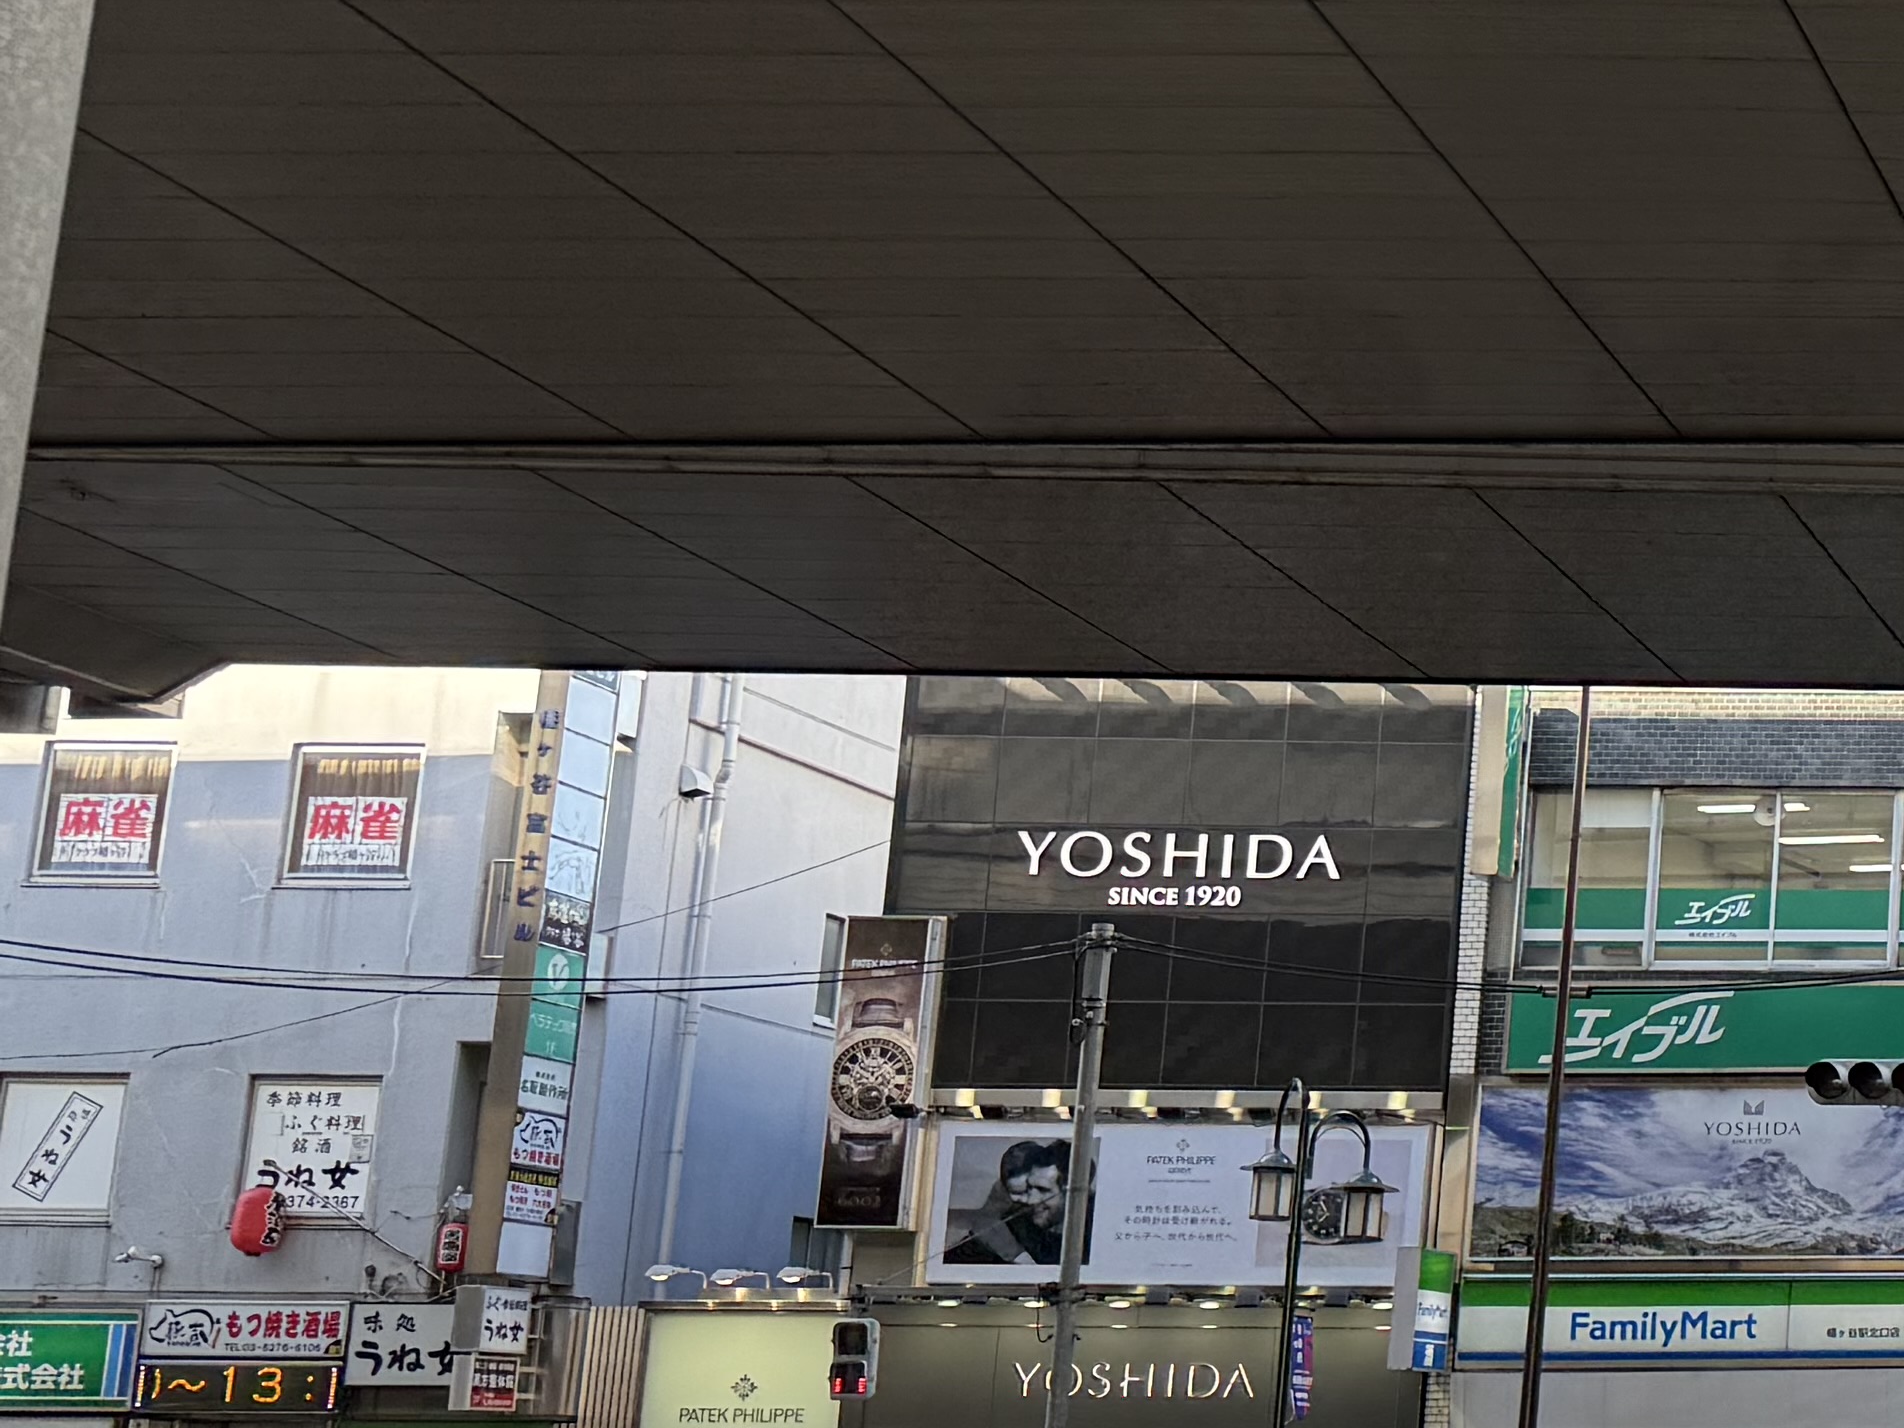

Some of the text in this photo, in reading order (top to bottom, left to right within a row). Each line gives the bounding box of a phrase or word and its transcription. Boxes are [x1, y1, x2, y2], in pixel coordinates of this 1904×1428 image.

[59, 797, 152, 840] 麻雀
[308, 800, 403, 842] 麻雀
[1017, 830, 1341, 881] YOSHIDA
[1107, 886, 1242, 907] SINCE 1920
[1674, 893, 1756, 926] エイブル
[1537, 990, 1735, 1064] エイブル
[266, 1090, 344, 1108] 季節料理
[1703, 1121, 1802, 1137] YOSHIDA
[291, 1137, 332, 1155] 銘酒
[1146, 1155, 1174, 1166] PATEK
[226, 1310, 342, 1339] もつ焼き酒場
[363, 1310, 417, 1334] 味処
[1569, 1310, 1758, 1348] FamilyMart
[0, 1329, 34, 1358] 社
[354, 1340, 473, 1377] うね女
[0, 1362, 85, 1391] 式会社
[678, 1407, 806, 1424] PATEK PHILIPPE
